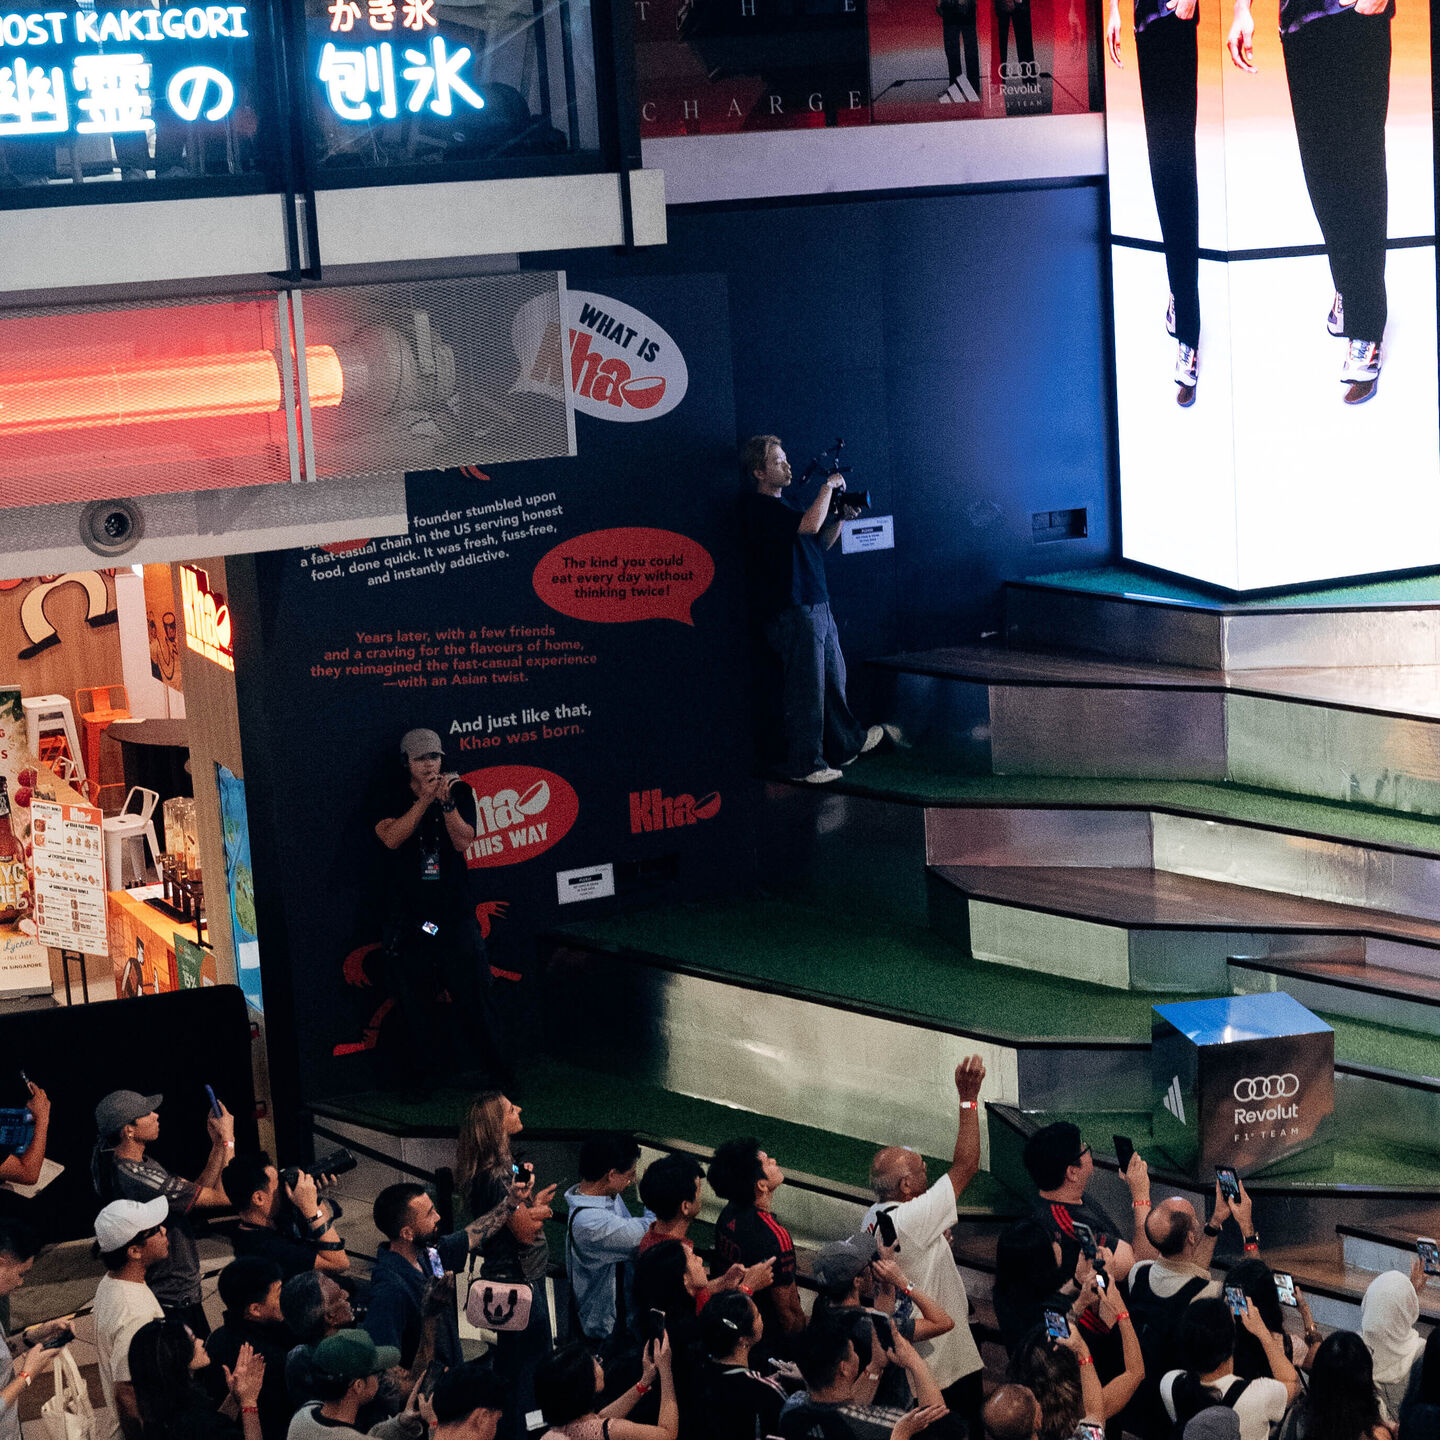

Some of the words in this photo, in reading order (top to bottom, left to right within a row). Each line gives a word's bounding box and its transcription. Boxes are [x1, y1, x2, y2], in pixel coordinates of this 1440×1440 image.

[76, 5, 249, 43] KAKIGORI
[999, 81, 1042, 95] Revolut
[579, 302, 638, 349] WHAT
[636, 337, 660, 363] IS
[413, 508, 463, 528] founder
[465, 497, 522, 518] stumbled
[525, 491, 557, 508] upon
[300, 559, 308, 567] a
[310, 541, 377, 565] fast-casual
[380, 537, 413, 551] chain
[415, 533, 427, 544] in
[430, 528, 450, 540] the
[454, 521, 472, 536] US
[475, 515, 519, 534] serving
[522, 505, 563, 522] honest
[310, 565, 345, 581] food,
[348, 558, 381, 573] done
[384, 551, 421, 567] quick.
[423, 546, 434, 558] It
[436, 543, 461, 555] was
[463, 533, 499, 550] fresh,
[501, 522, 558, 543] fuss-free,
[562, 556, 586, 569] The
[590, 556, 618, 569] kind
[621, 558, 646, 572] you
[649, 555, 684, 567] could
[367, 572, 391, 586] and
[393, 561, 447, 581] instantly
[449, 549, 510, 570] addictive.
[552, 572, 573, 584] eat
[577, 573, 612, 586] every
[615, 570, 640, 585] day
[644, 570, 694, 582] without
[574, 586, 626, 601] thinking
[630, 585, 670, 598] twice!
[356, 632, 393, 644] Years
[396, 629, 431, 643] later,
[435, 627, 465, 640] with
[469, 630, 477, 638] a
[481, 626, 506, 638] few
[509, 624, 556, 637] friends
[324, 648, 349, 661] and
[354, 651, 362, 659] a
[366, 647, 415, 661] craving
[420, 644, 441, 657] for
[444, 643, 465, 656] the
[469, 642, 524, 654] flavours
[527, 639, 541, 651] of
[544, 639, 584, 652] home,
[310, 665, 341, 679] they
[345, 660, 422, 677] reimagined
[426, 659, 449, 671] the
[452, 655, 522, 671] fast-casual
[526, 653, 597, 669] experience
[430, 677, 447, 686] an
[451, 672, 488, 685] Asian
[492, 671, 529, 683] twist.
[449, 716, 483, 735] And
[487, 712, 518, 733] just
[521, 708, 550, 725] like
[554, 703, 592, 721] that,
[459, 734, 501, 751] Khao
[506, 731, 538, 744] was
[542, 724, 585, 739] born.
[465, 835, 504, 861] THIS
[508, 822, 549, 849] WAY
[1234, 1103, 1299, 1125] Revolut
[1261, 1127, 1299, 1139] TEAM
